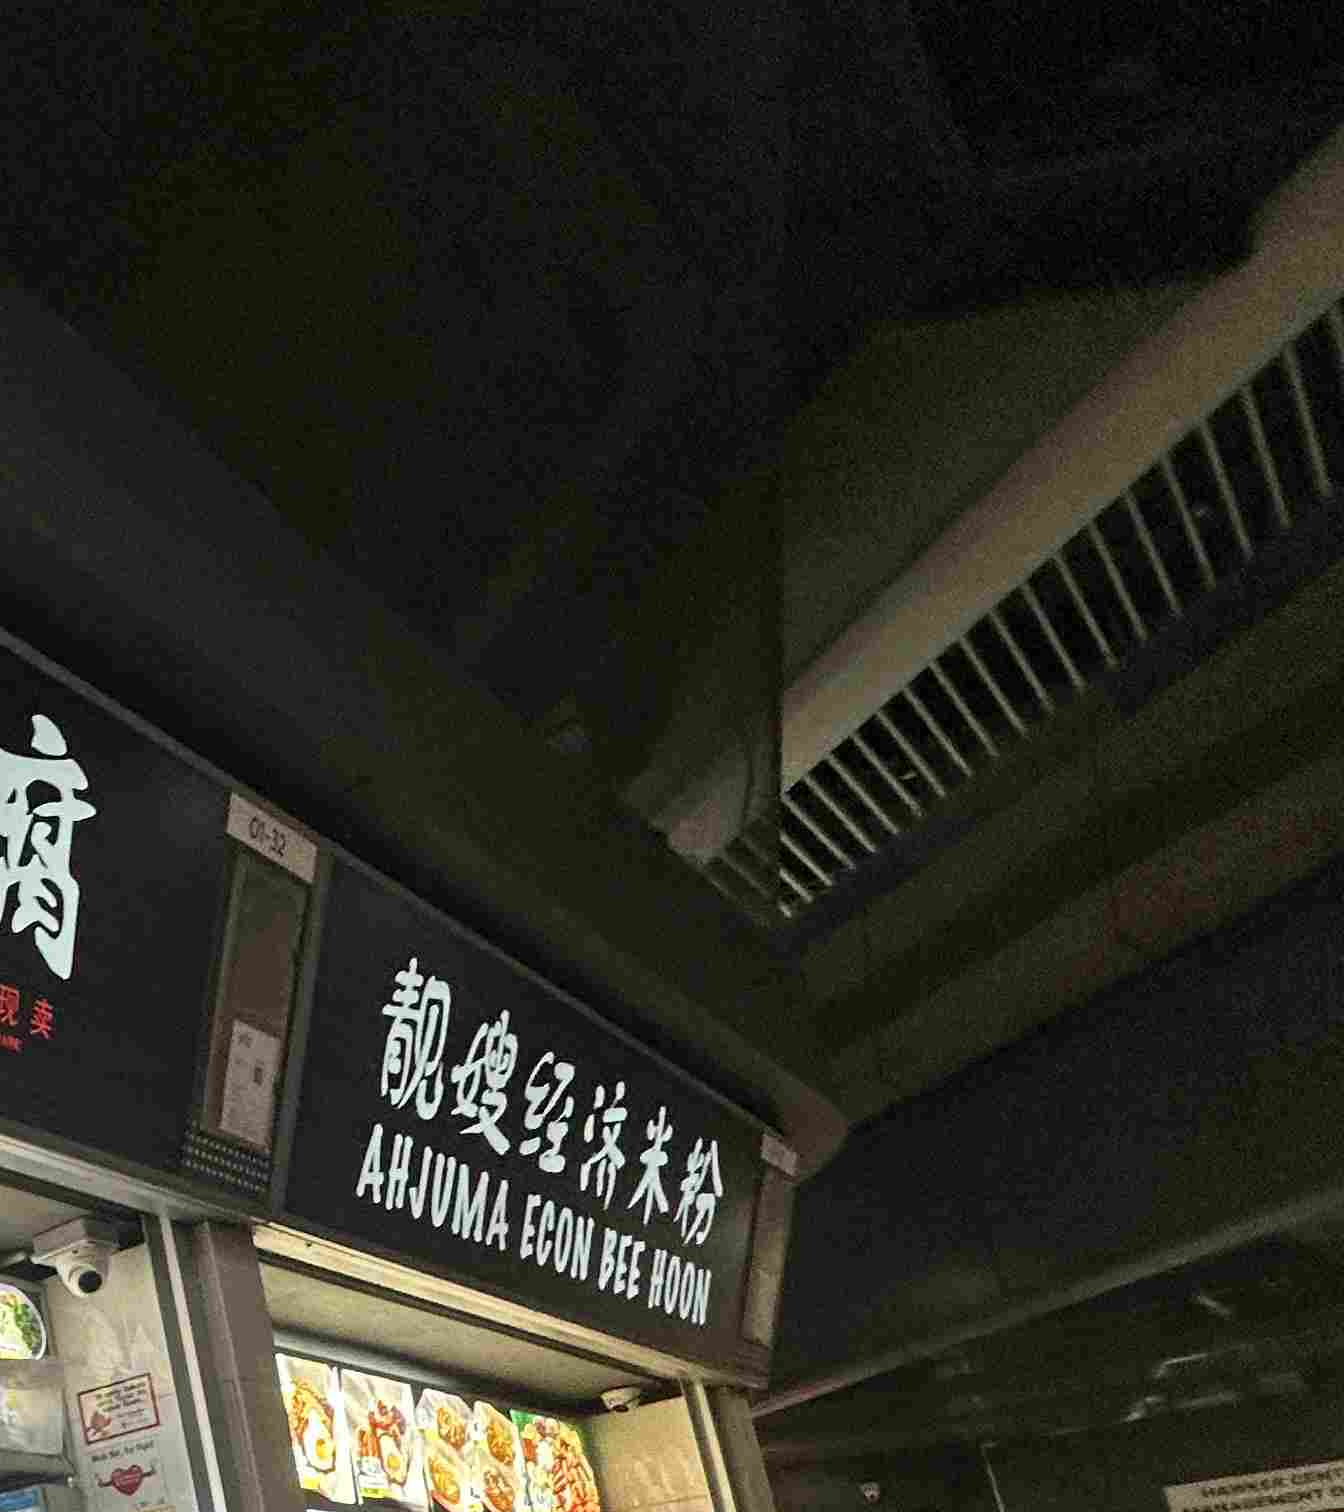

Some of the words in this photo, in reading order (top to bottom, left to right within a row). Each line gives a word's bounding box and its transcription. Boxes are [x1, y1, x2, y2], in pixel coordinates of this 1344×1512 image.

[356, 1123, 510, 1252] AHJUMA
[520, 1194, 595, 1281] ECON
[598, 1228, 647, 1301] BEE
[647, 1249, 711, 1327] HOON
